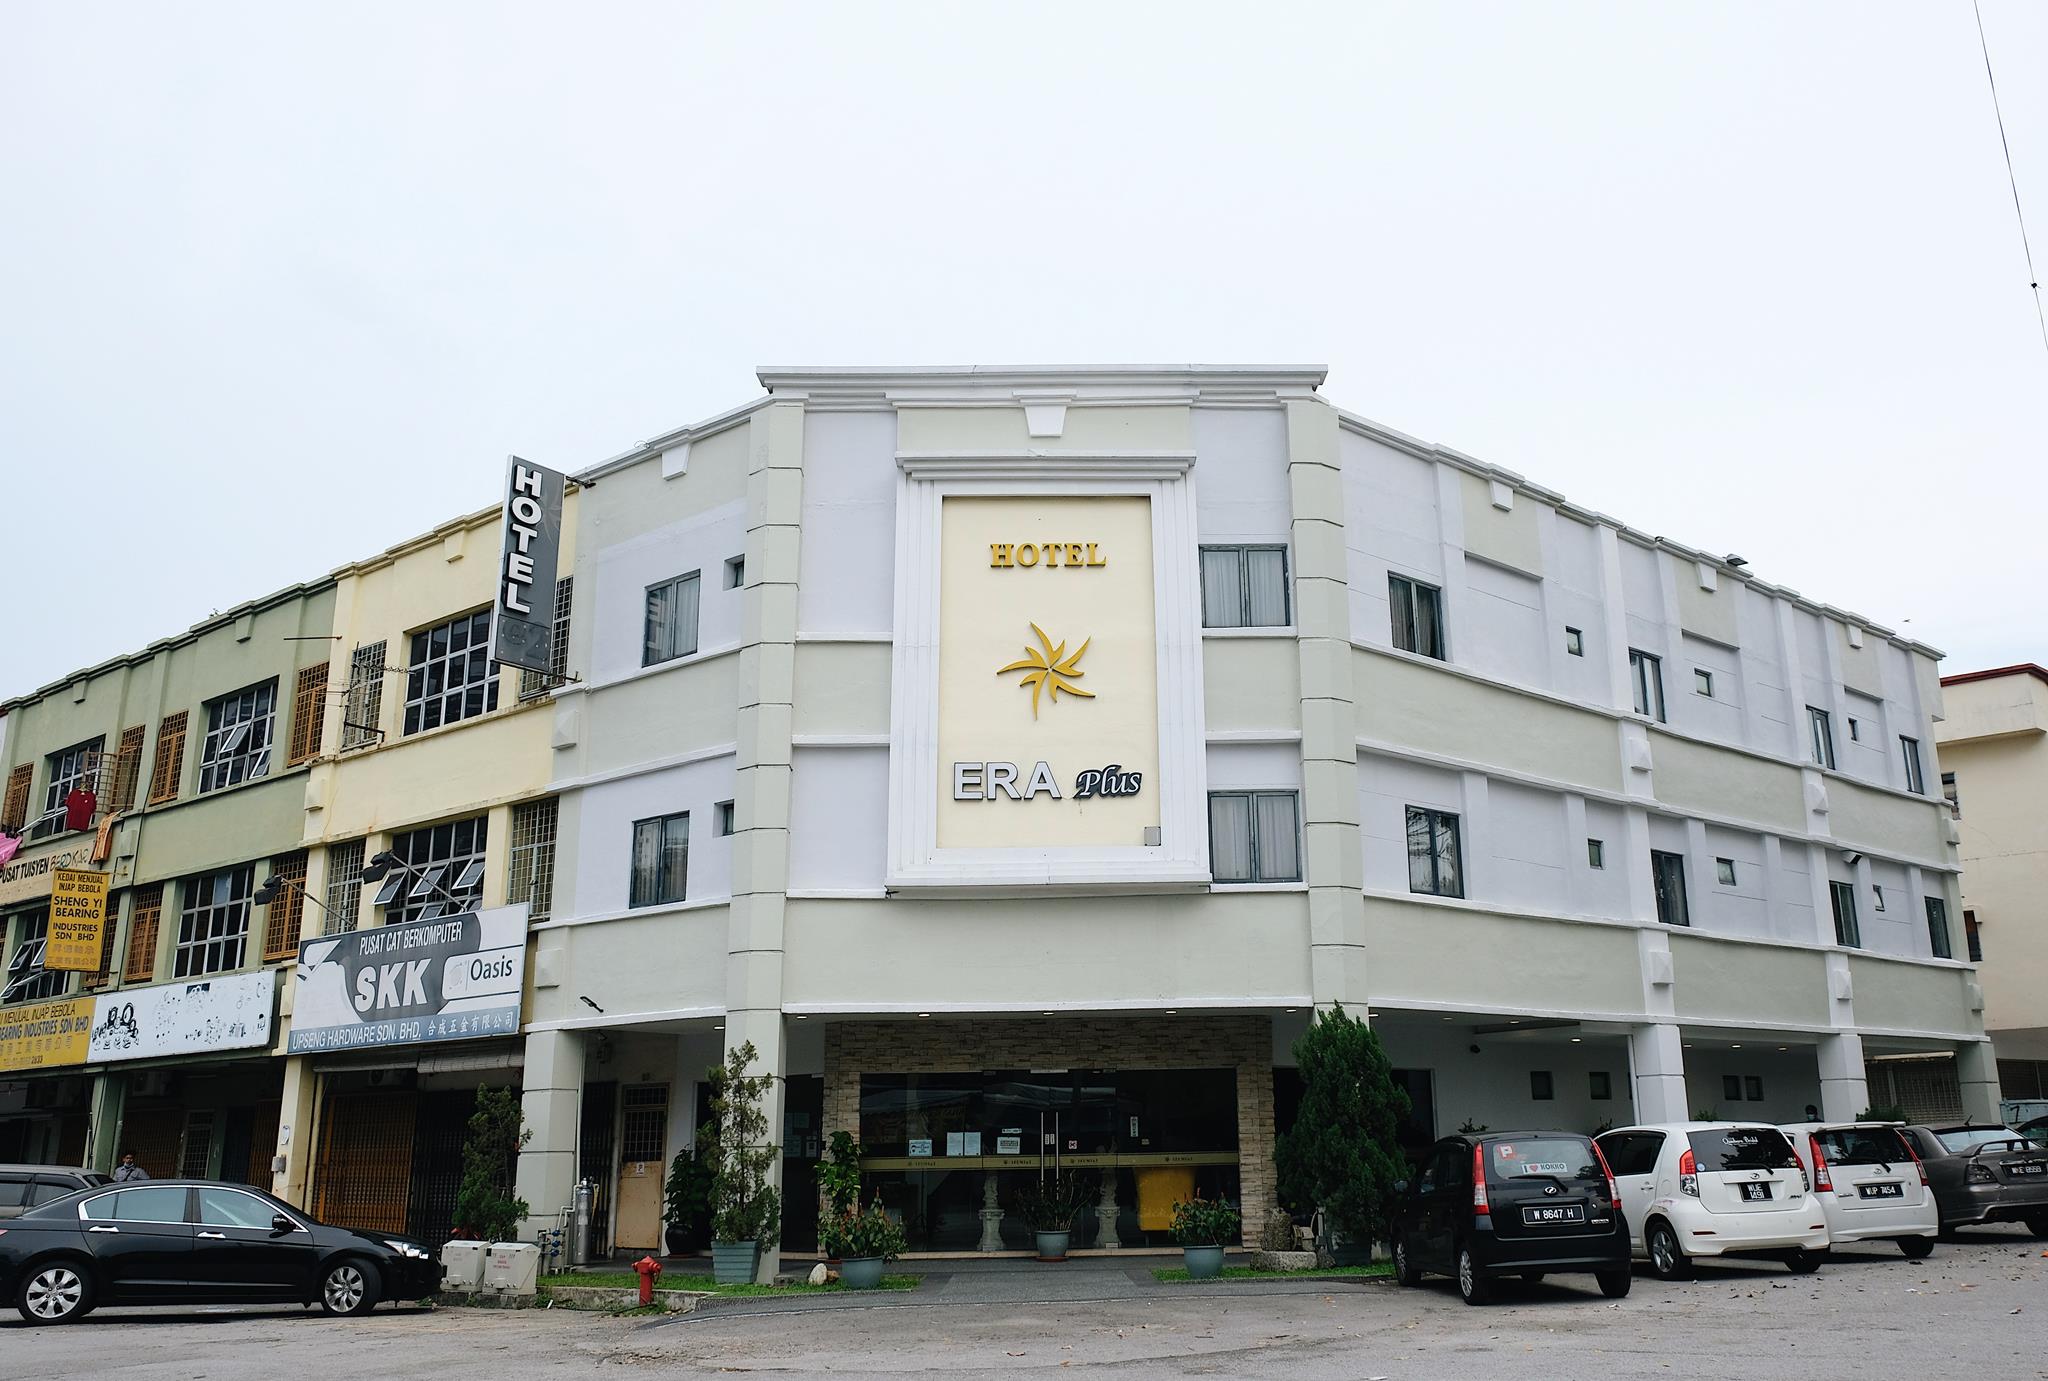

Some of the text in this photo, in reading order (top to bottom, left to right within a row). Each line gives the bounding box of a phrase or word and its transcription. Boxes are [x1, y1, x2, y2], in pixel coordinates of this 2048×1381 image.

[506, 464, 543, 614] HOTEL
[990, 543, 1107, 568] HOTEL
[953, 761, 1142, 801] ERA Plus
[0, 864, 20, 884] PUSAT
[20, 857, 50, 880] TUISYEN
[57, 873, 104, 884] KEDAI MENJUAL
[59, 883, 101, 893] INJAP BEBOLA
[54, 896, 102, 908] SHENG YI
[56, 907, 99, 918] BEARING
[53, 922, 98, 932] INDUSTRIES
[55, 932, 95, 941] SDN BHD
[359, 920, 463, 956] PUSAT CAT BERKOMPUTER
[470, 955, 513, 981] Oasis
[354, 958, 431, 1013] SKK
[50, 1003, 76, 1018] BEBOLA
[24, 1018, 57, 1038] INDUSTRIES
[60, 1017, 73, 1034] SDN
[75, 1015, 89, 1032] BHD
[292, 1021, 421, 1050] UPSENG HARDWARE SDN. BHD.
[1533, 1208, 1574, 1220] W 8647 H
